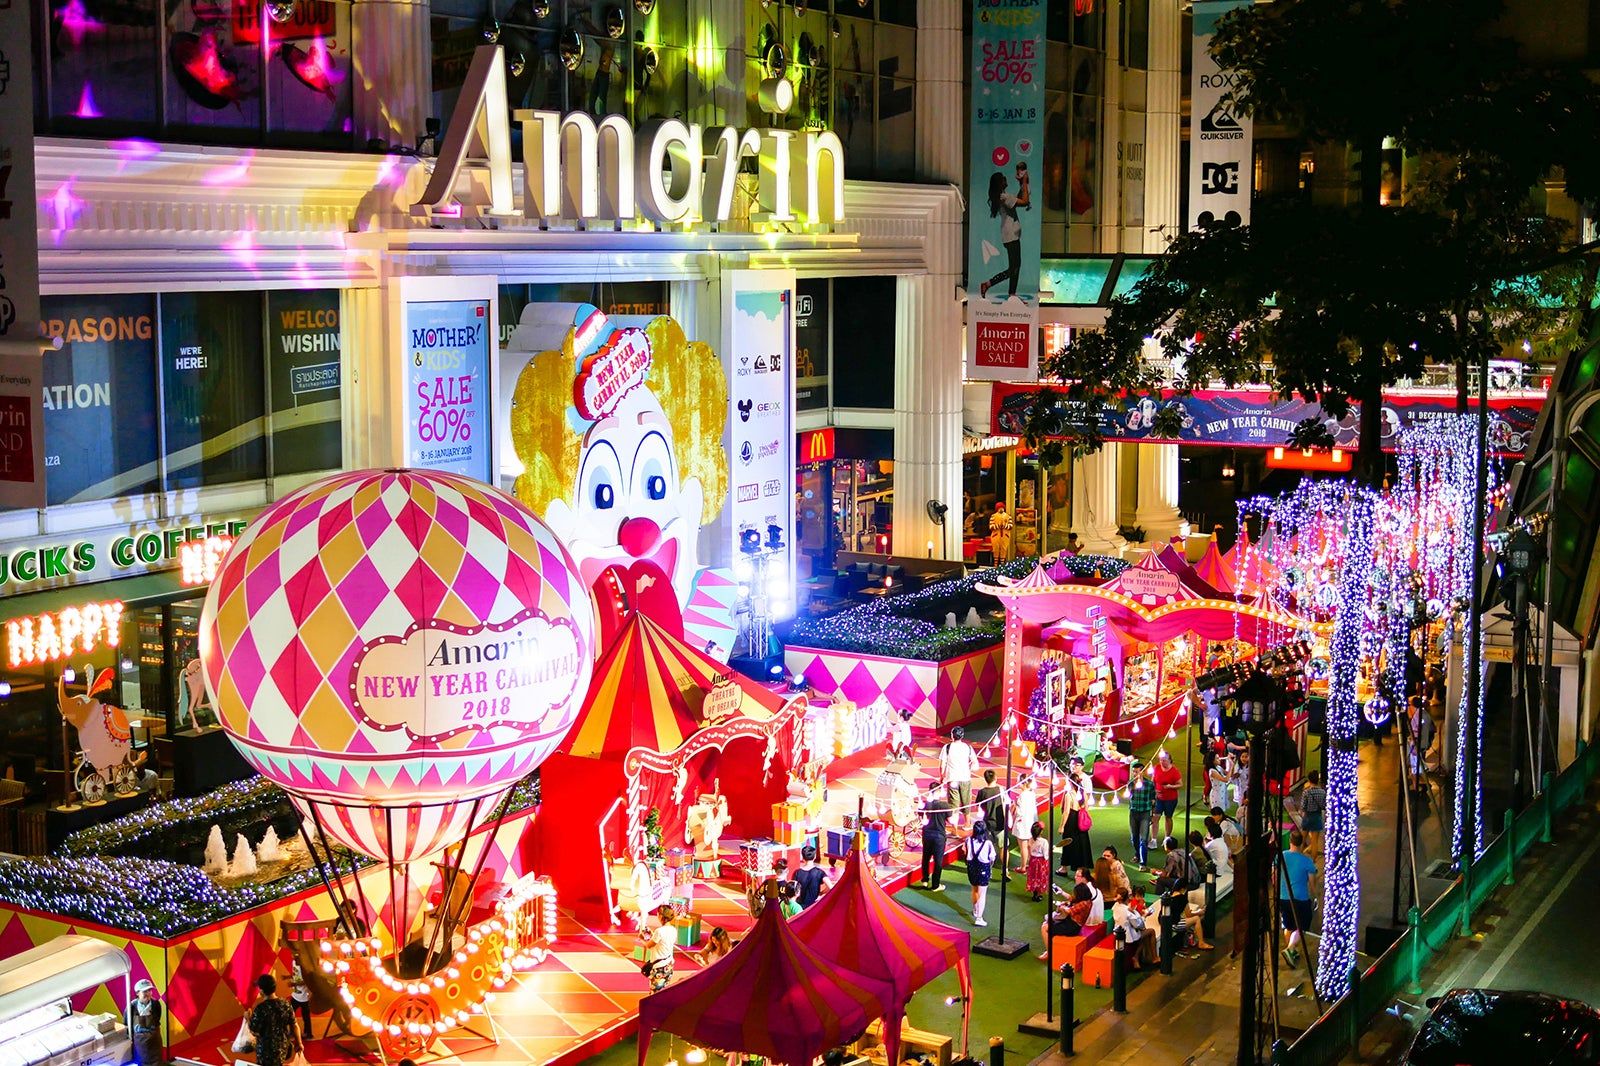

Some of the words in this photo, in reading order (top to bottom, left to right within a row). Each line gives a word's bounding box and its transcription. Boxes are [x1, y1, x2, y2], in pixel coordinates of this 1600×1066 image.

[982, 40, 1035, 65] SALE
[982, 61, 1032, 85] 60%
[1003, 108, 1023, 120] JAN
[1027, 108, 1037, 119] 18
[411, 44, 846, 223] Amarin
[1200, 132, 1244, 141] QUIKSILVER
[281, 309, 340, 330] WELCO
[412, 323, 482, 349] MOTHER!
[978, 326, 1026, 340] Amarin
[981, 340, 1024, 353] BRAND
[175, 357, 208, 370] HERE!
[414, 351, 423, 367] &
[988, 352, 1015, 364] SALE
[417, 375, 473, 412] SALE
[757, 401, 781, 412] GEOX
[1242, 407, 1272, 416] Amarin
[418, 407, 471, 443] 60%
[1206, 419, 1229, 434] NEW
[1231, 416, 1258, 428] YEAR
[1260, 416, 1298, 433] CARNIV
[1248, 428, 1267, 438] 2018
[6, 600, 123, 668] HAPPY
[427, 630, 540, 668] Amarin
[363, 675, 420, 699] NEW
[430, 670, 489, 698] YEAR
[495, 652, 577, 691] CARNIVAL
[461, 696, 511, 721] 2018
